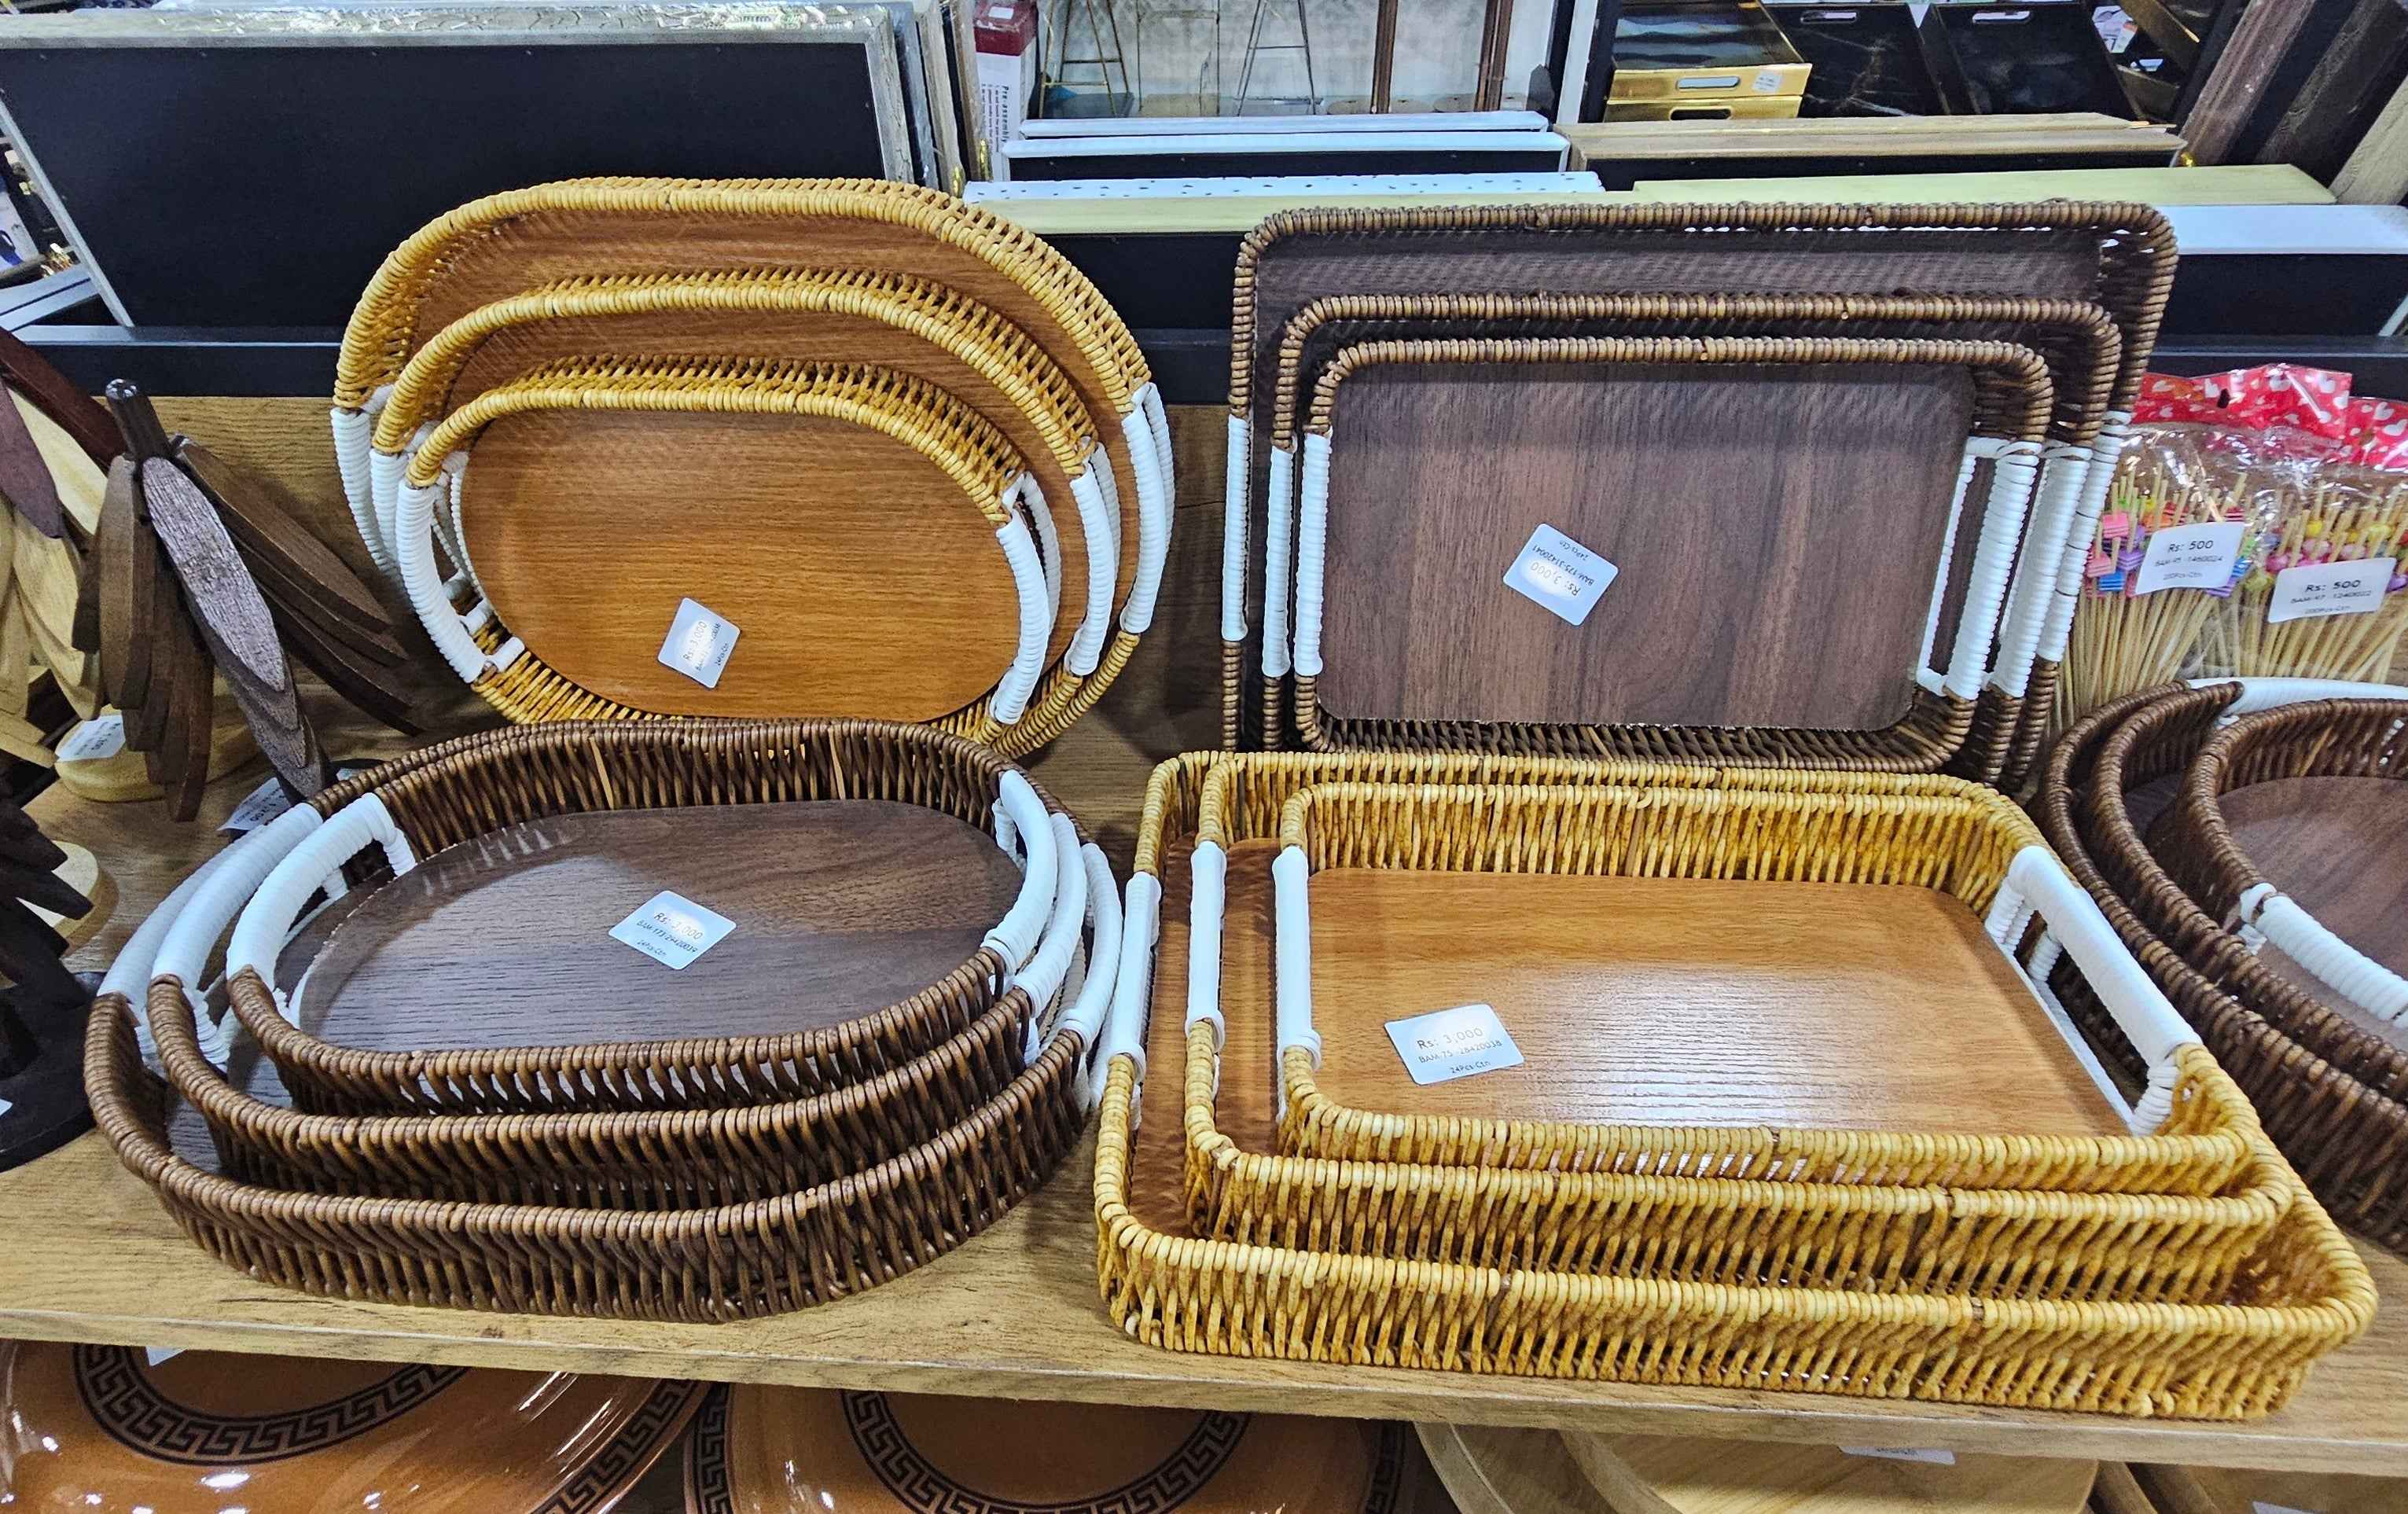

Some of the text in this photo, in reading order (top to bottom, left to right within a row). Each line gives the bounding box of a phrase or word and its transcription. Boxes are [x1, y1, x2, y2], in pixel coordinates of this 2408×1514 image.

[2189, 540, 2214, 550] 500
[1531, 561, 1581, 596] Rs: 3,000
[2333, 579, 2361, 590] 500
[1417, 1027, 1483, 1049] Rs: 3,000
